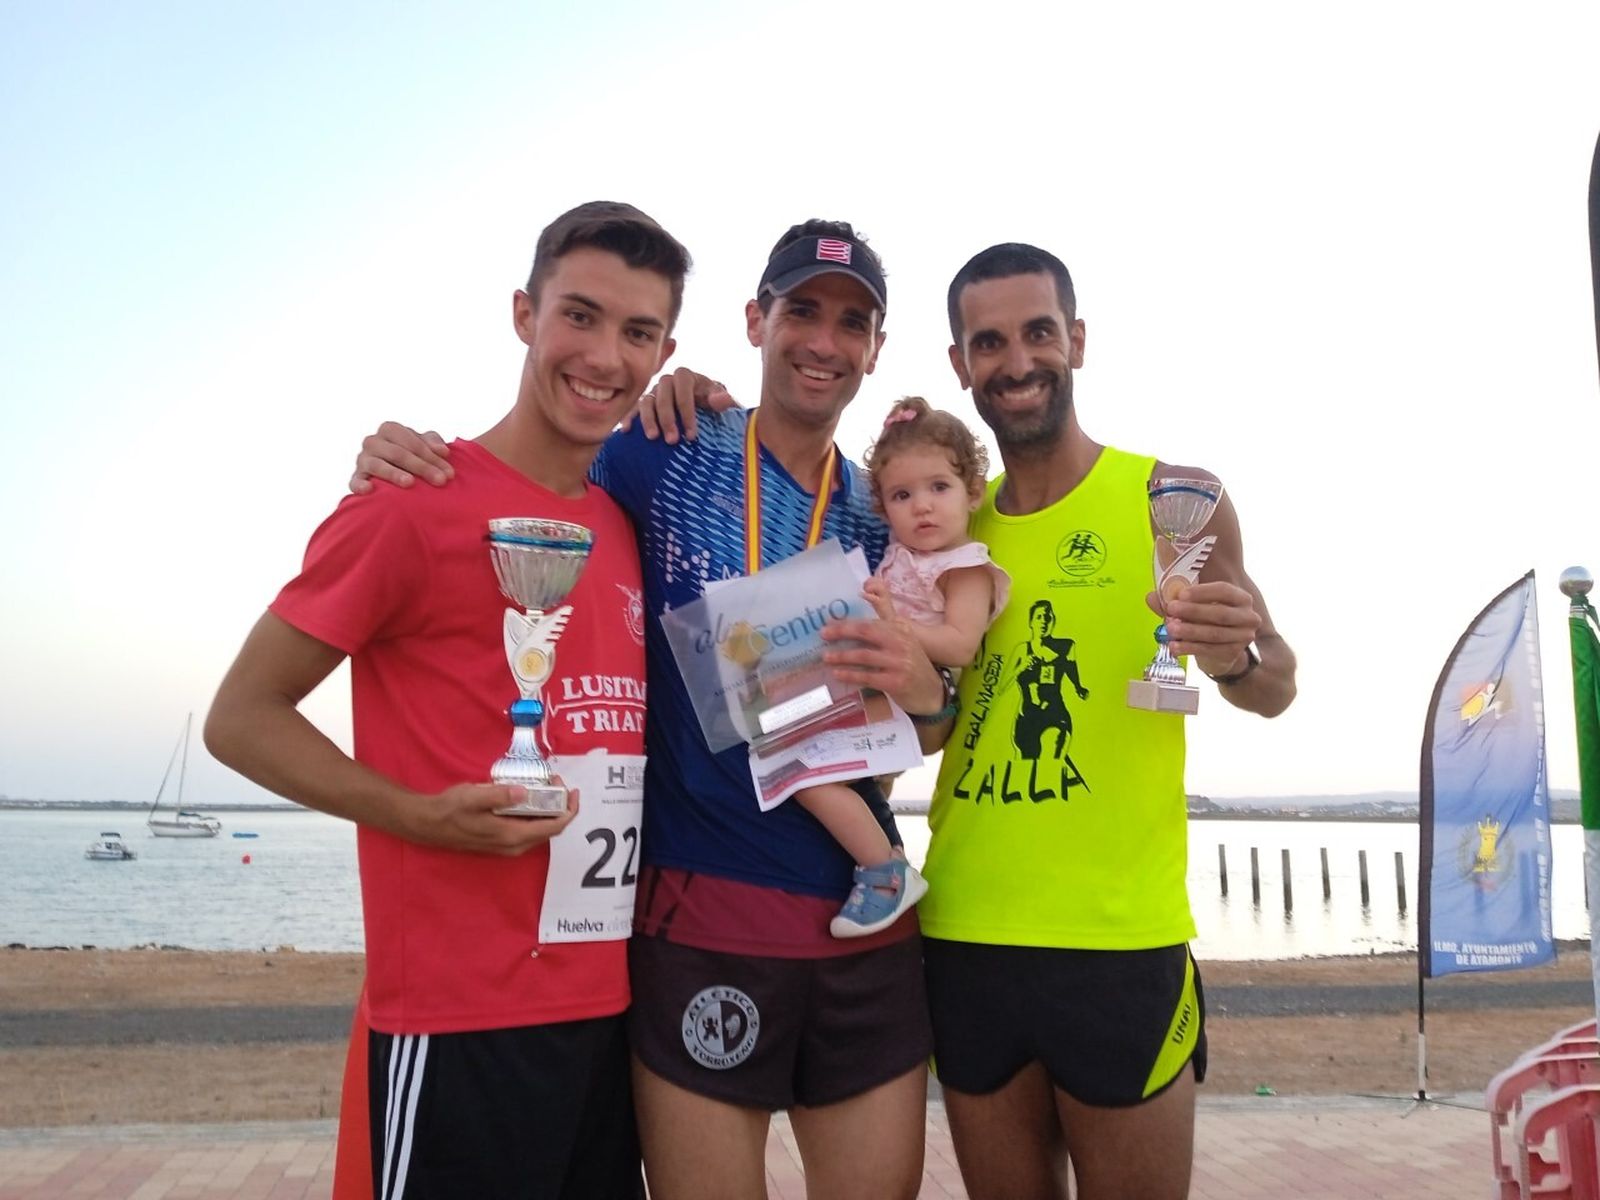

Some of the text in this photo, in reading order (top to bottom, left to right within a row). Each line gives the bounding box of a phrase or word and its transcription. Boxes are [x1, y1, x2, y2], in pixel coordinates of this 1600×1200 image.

[963, 653, 1003, 751] BALMASEDA
[581, 826, 637, 889] 22
[557, 917, 604, 933] Huelva
[1455, 954, 1469, 966] DE
